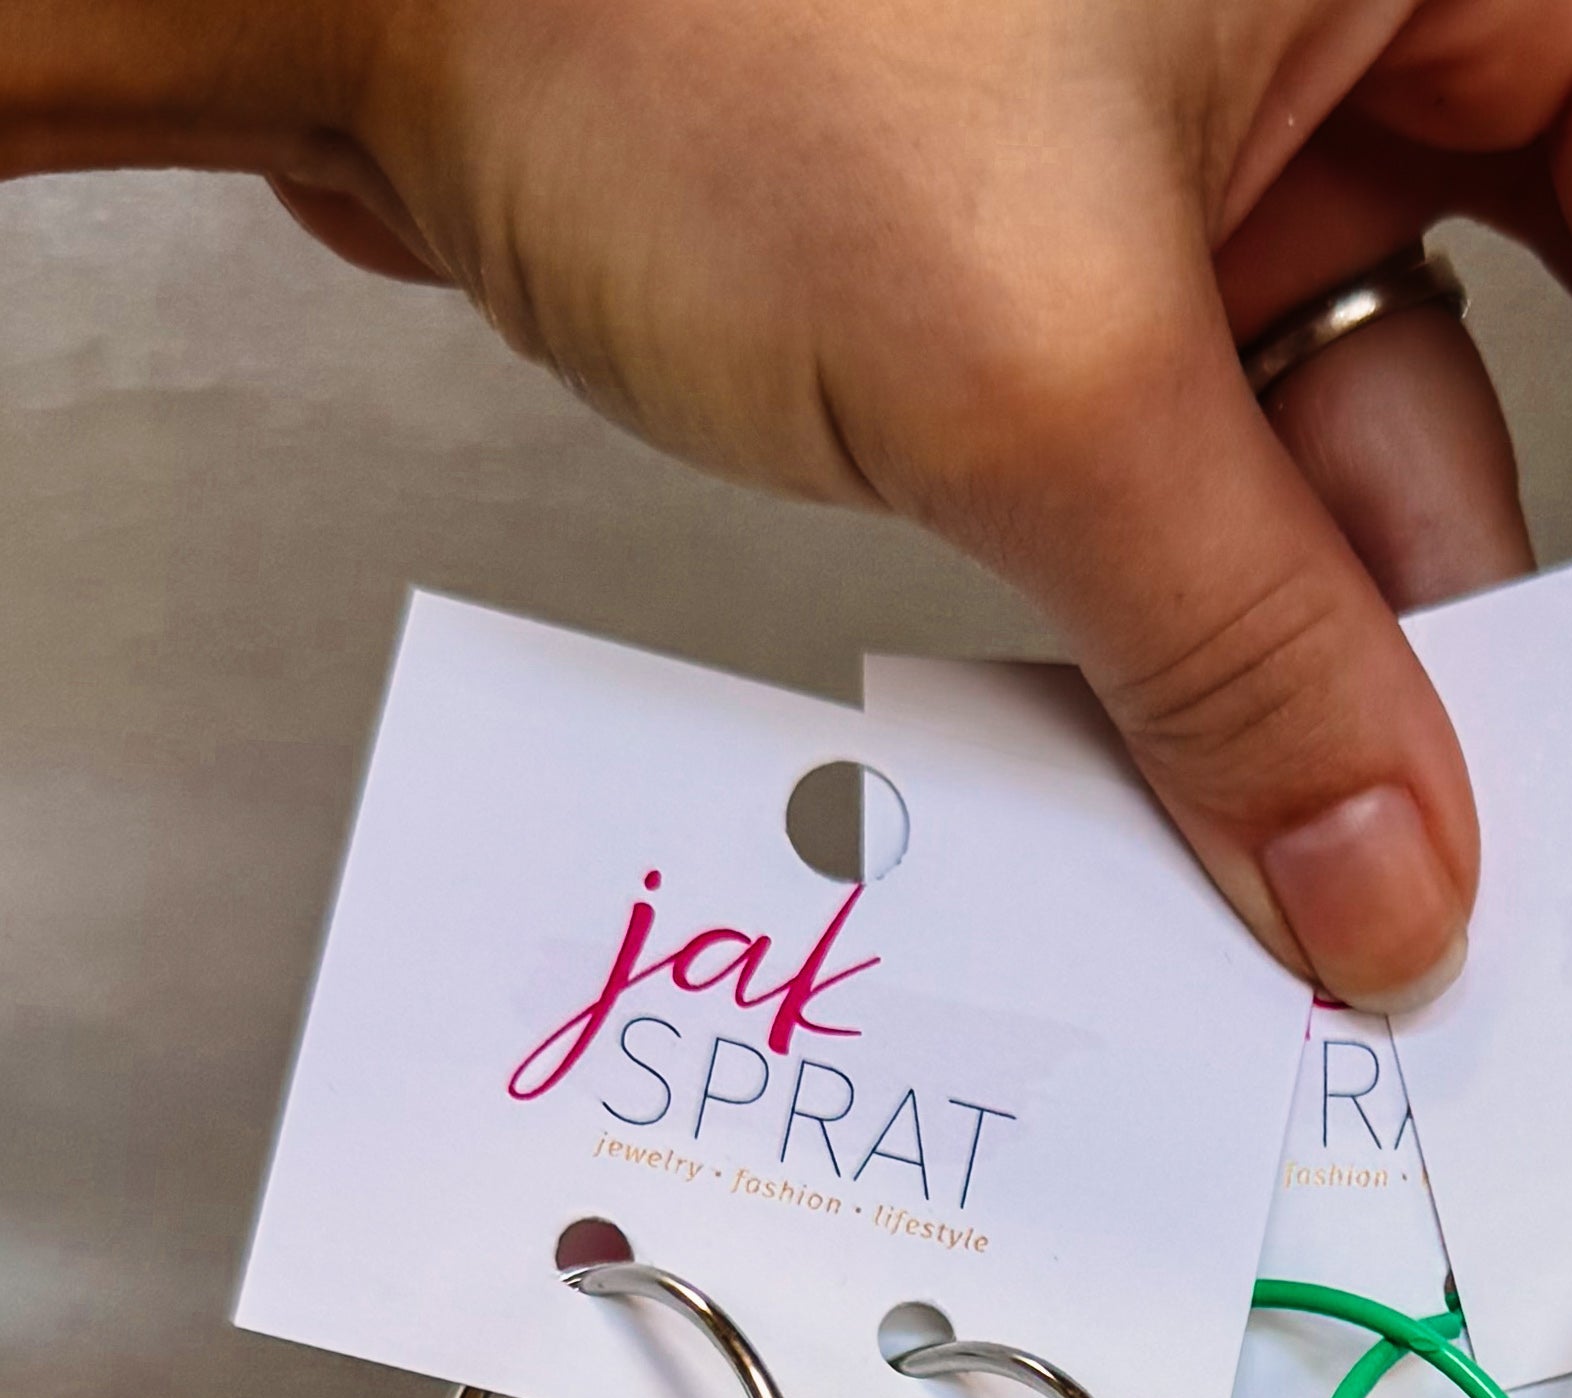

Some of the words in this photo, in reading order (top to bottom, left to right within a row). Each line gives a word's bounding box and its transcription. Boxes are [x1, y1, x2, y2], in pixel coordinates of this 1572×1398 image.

[508, 869, 881, 1101] jak
[602, 1017, 1016, 1209] SPRAT
[1282, 1161, 1389, 1189] fashion
[592, 1131, 703, 1182] jewelry
[731, 1167, 842, 1215] fashion
[874, 1204, 989, 1255] lifestyle
